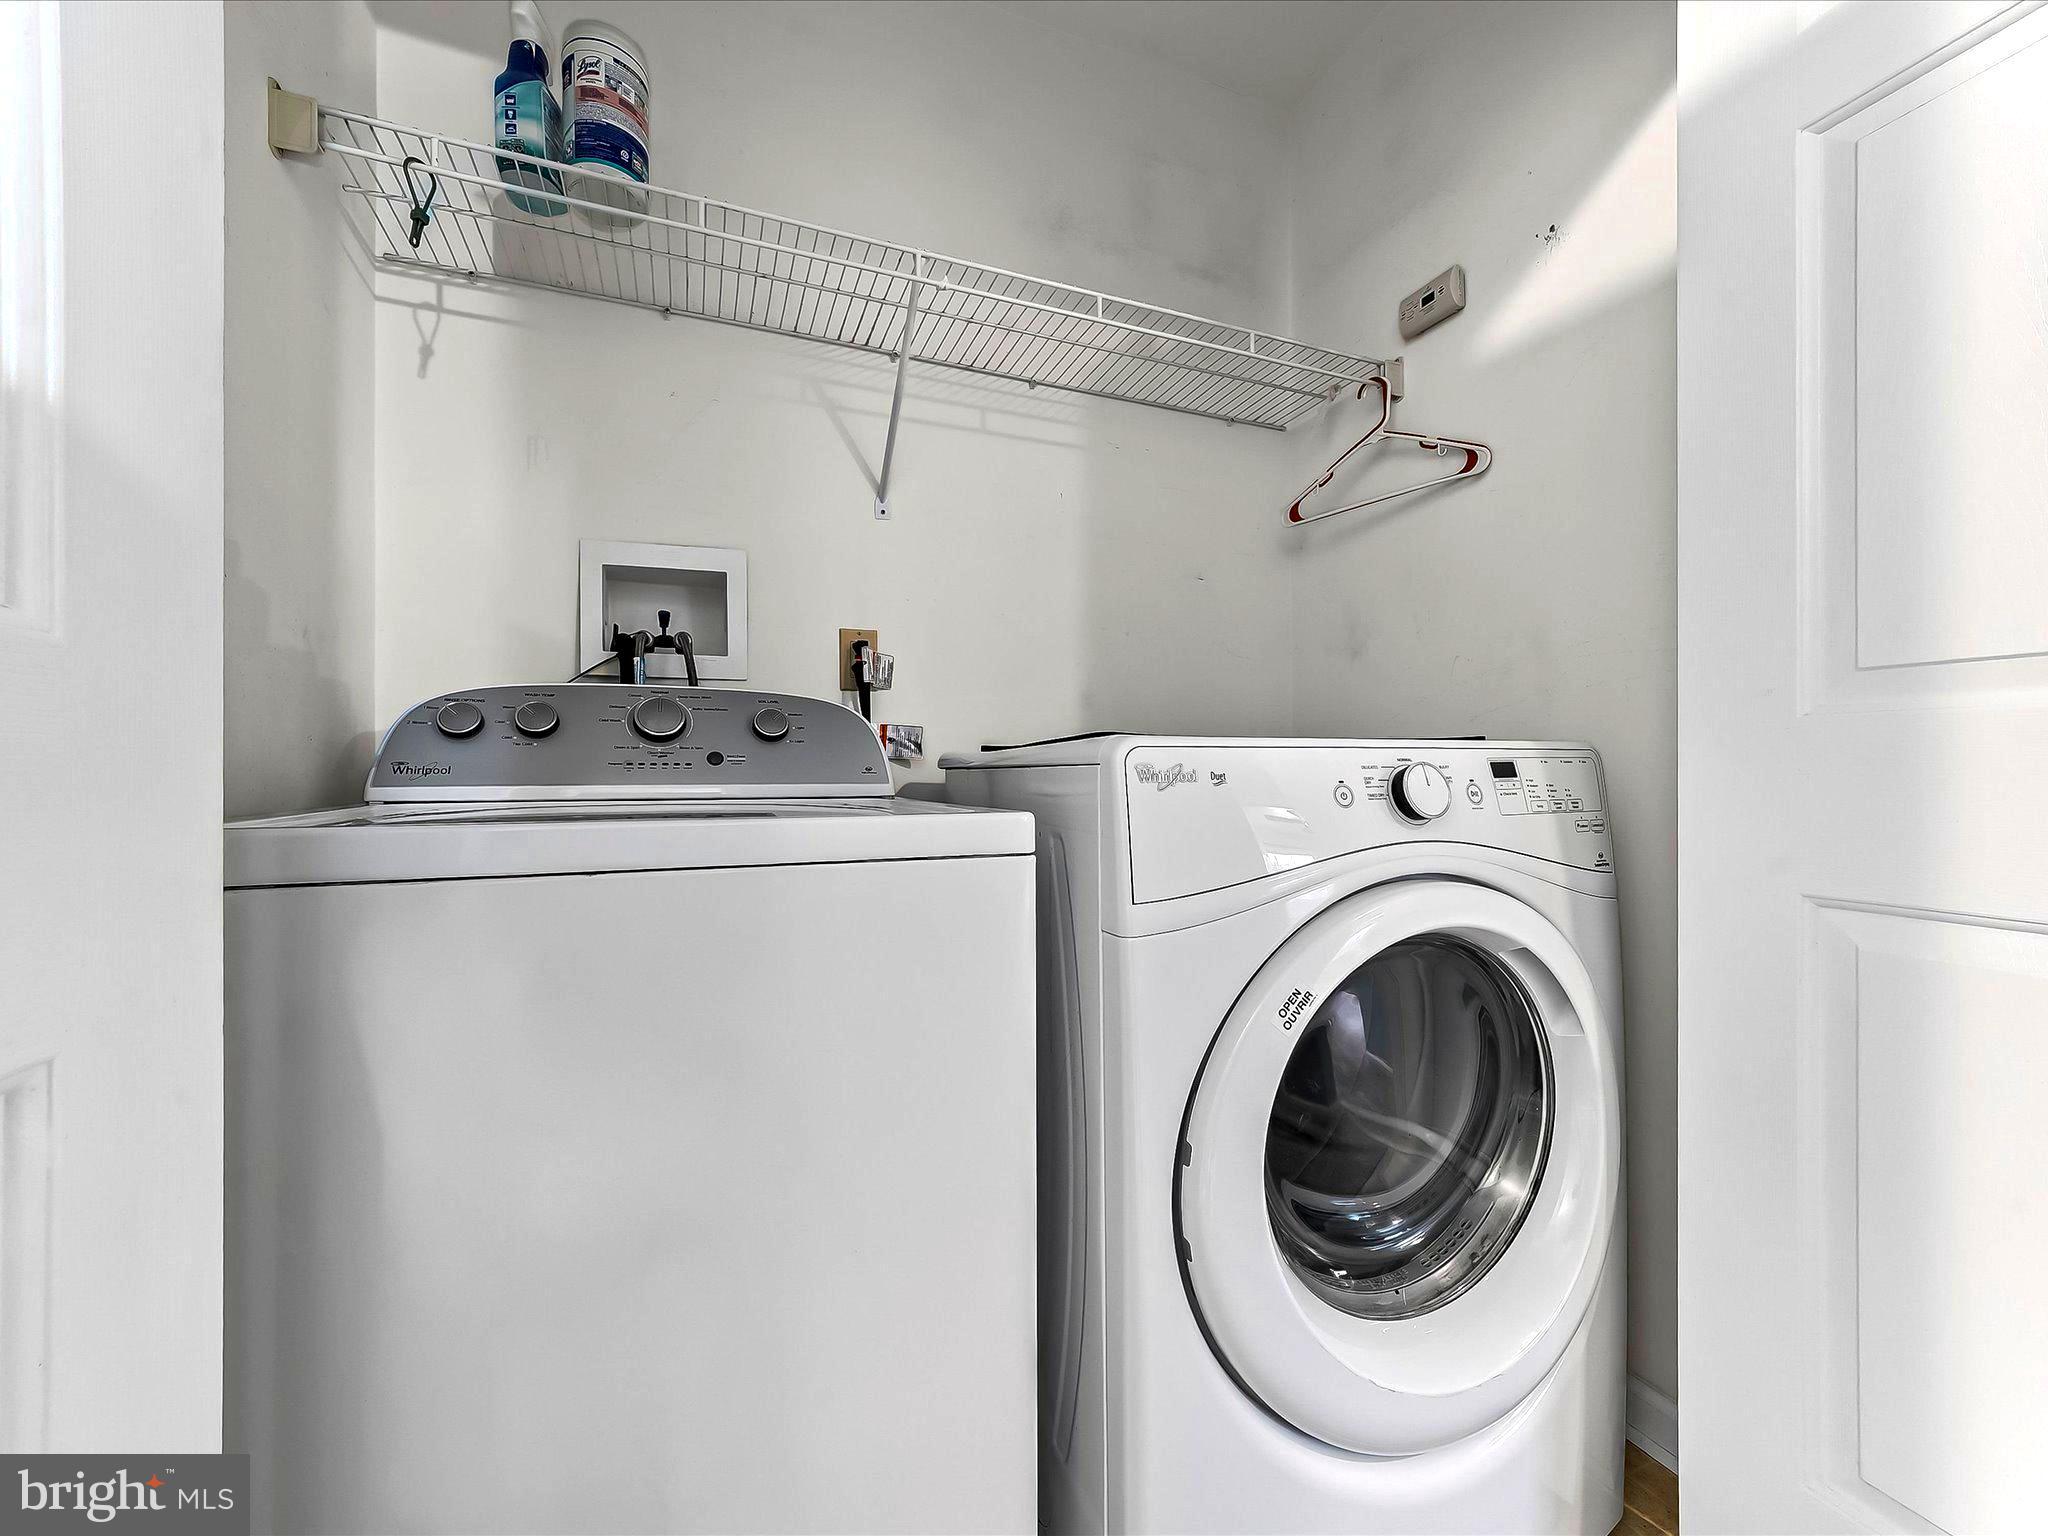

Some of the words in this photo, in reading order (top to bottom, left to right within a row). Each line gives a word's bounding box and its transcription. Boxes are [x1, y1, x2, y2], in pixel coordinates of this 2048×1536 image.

[391, 764, 451, 777] Whirlpool
[1210, 771, 1226, 781] Duet
[1278, 988, 1302, 1019] OPEN
[1283, 991, 1314, 1031] OUVRIR
